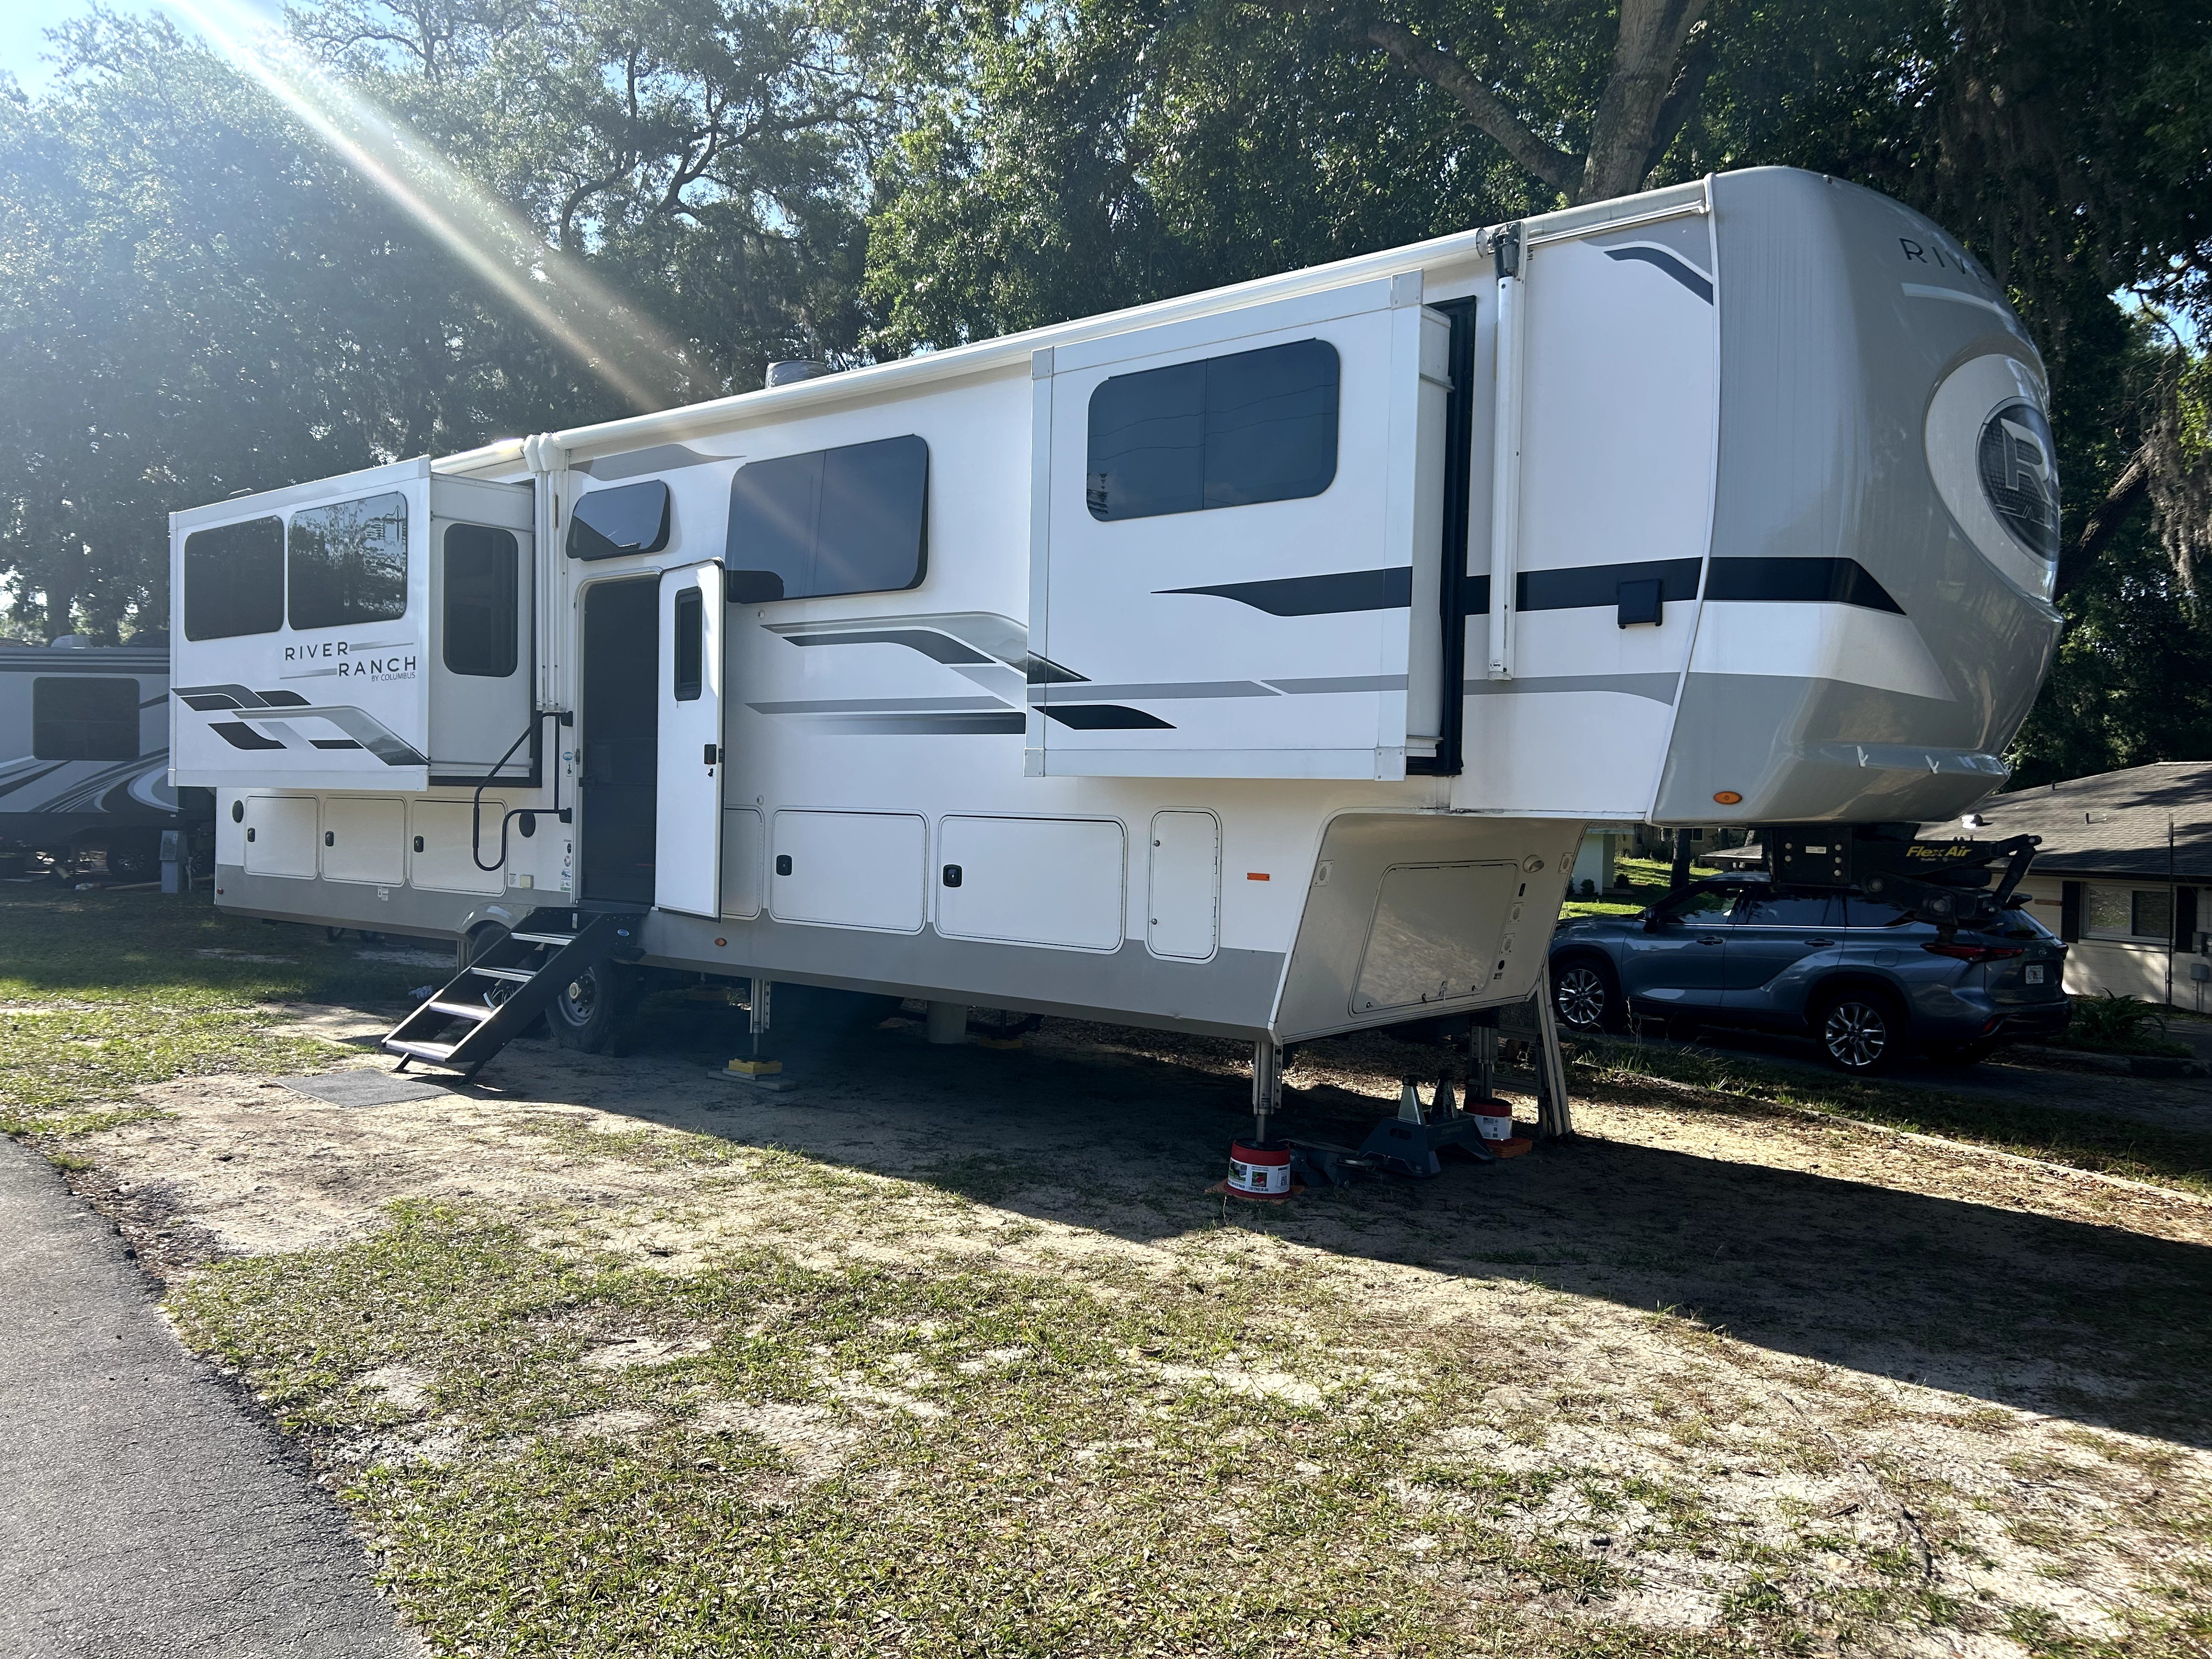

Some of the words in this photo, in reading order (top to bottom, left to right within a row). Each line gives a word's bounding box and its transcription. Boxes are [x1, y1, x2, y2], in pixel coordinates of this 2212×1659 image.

[285, 641, 348, 661] RIVER
[338, 656, 416, 676] RANCH
[381, 671, 416, 681] COLUMBUS
[1944, 845, 1973, 857] Air
